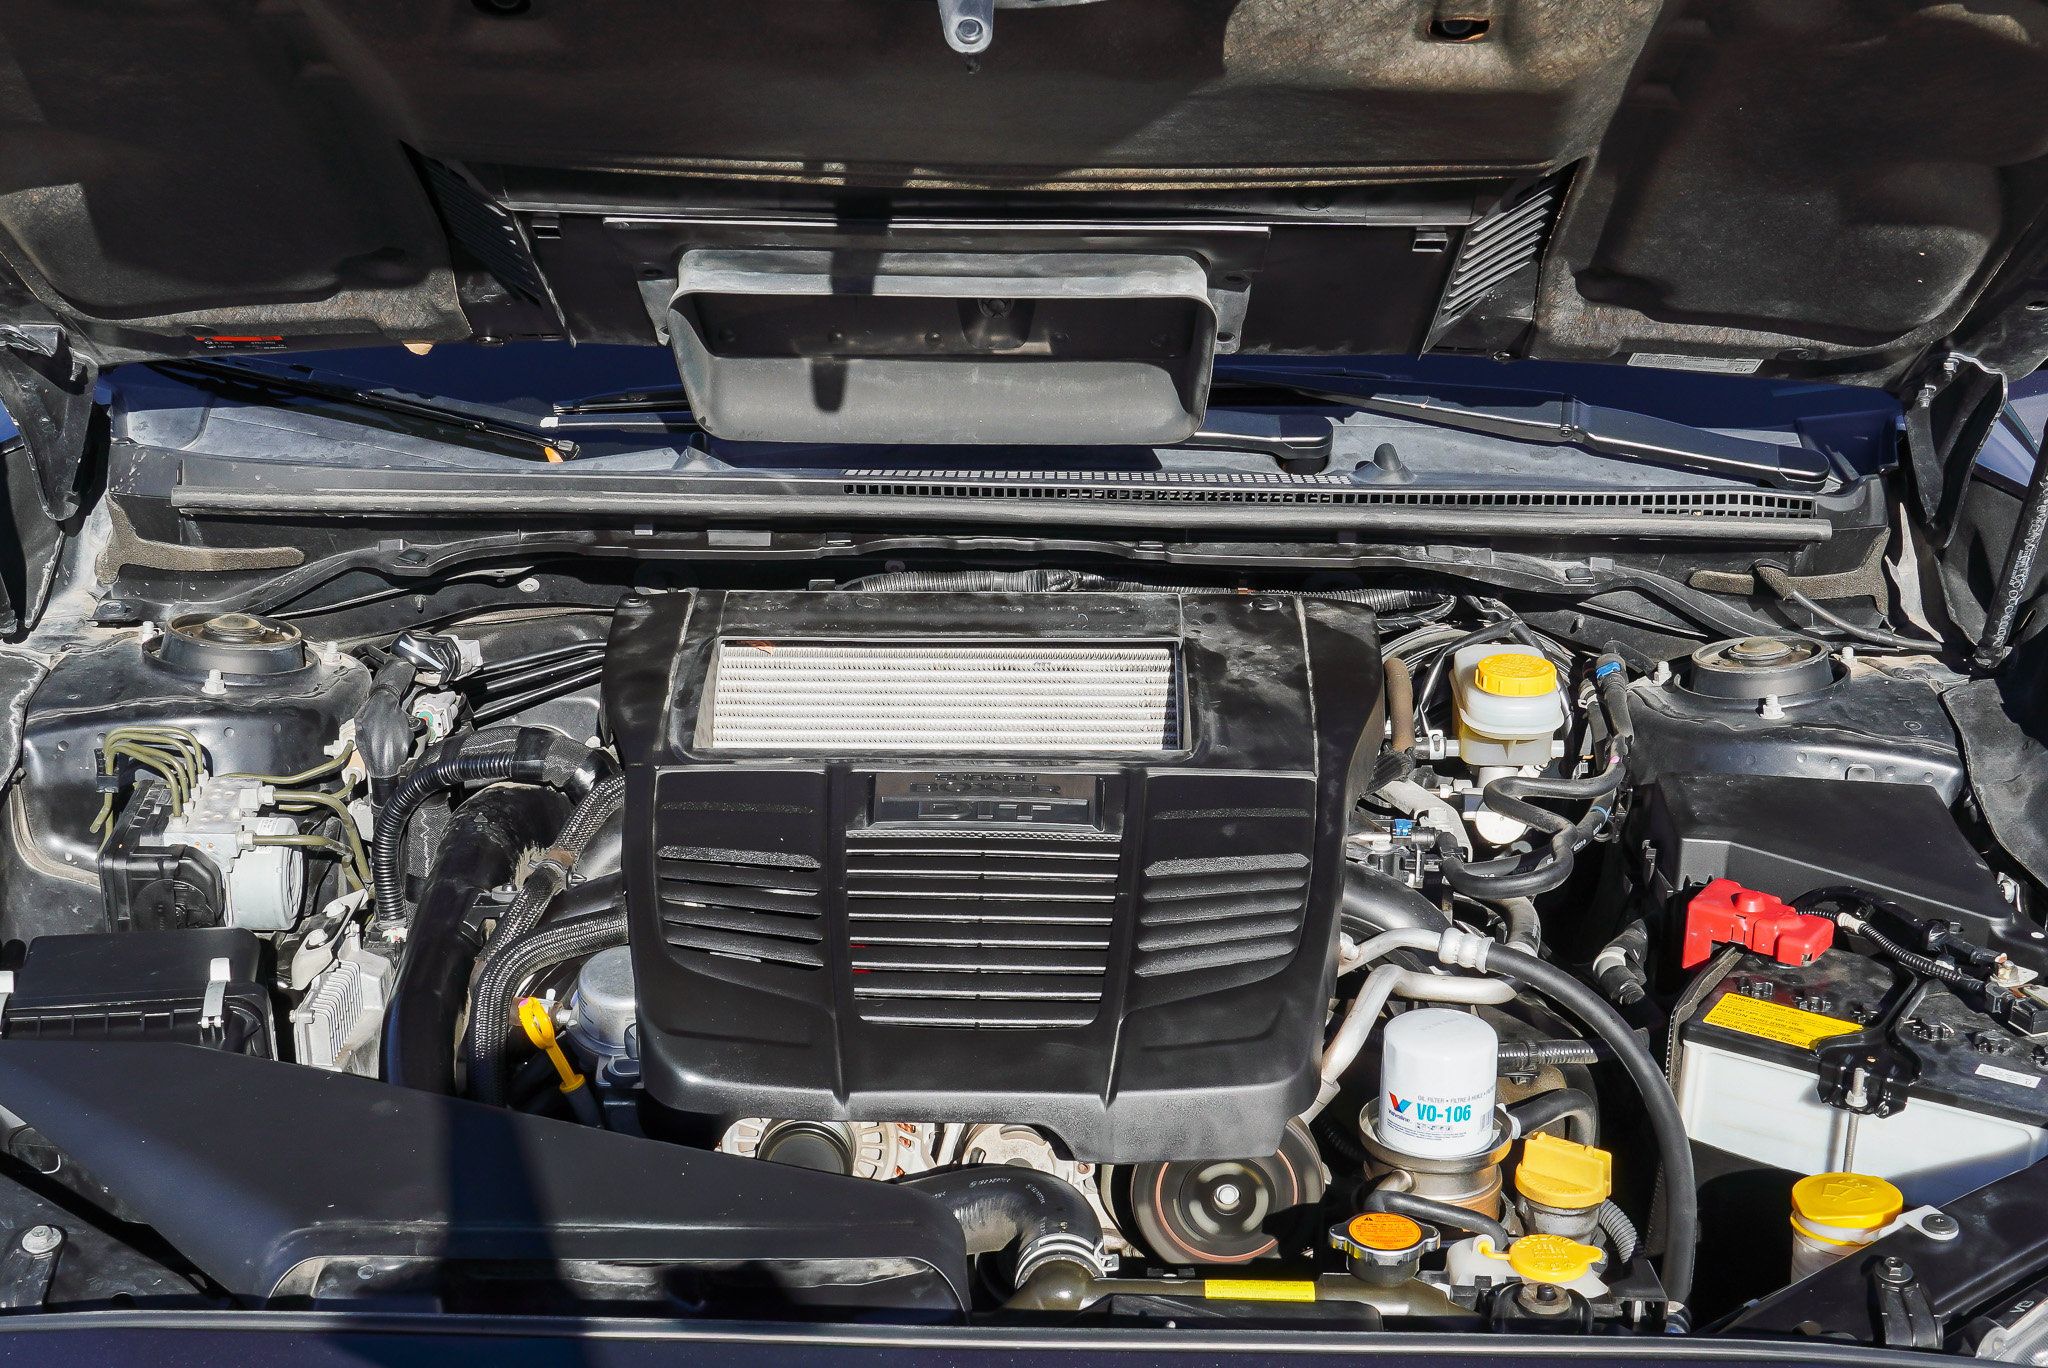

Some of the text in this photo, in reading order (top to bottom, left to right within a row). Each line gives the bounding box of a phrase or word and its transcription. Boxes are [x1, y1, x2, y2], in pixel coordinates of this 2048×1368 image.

[910, 782, 1062, 795] BOXER
[1727, 995, 1760, 1005] DANGER
[1716, 1008, 1748, 1018] POISON
[1417, 1103, 1472, 1122] VO-106
